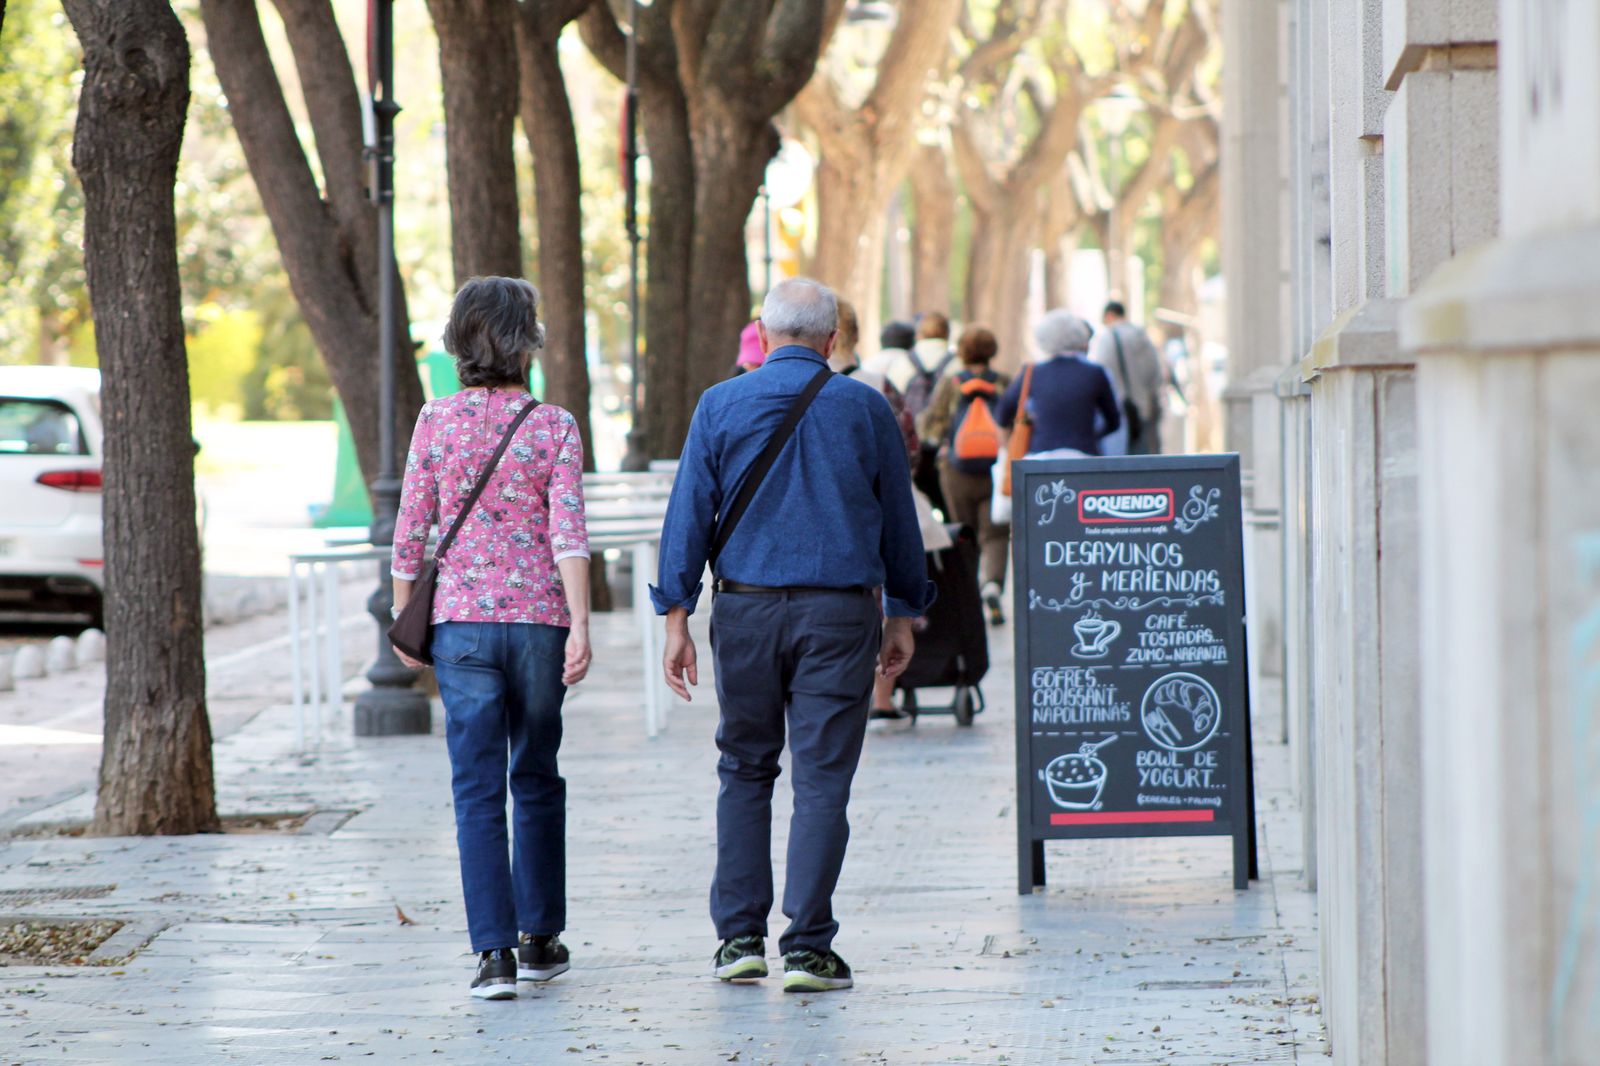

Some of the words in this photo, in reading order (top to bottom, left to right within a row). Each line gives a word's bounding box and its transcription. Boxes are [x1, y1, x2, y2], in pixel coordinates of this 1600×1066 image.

[1084, 494, 1168, 518] OQUENDO
[1045, 541, 1183, 566] DESAYUNOS
[1125, 648, 1165, 662] ZUMO
[1174, 646, 1227, 661] NARANJA
[1032, 706, 1131, 723] NAPOLITANAS
[1136, 751, 1183, 767] BOWL
[1194, 751, 1218, 767] DE
